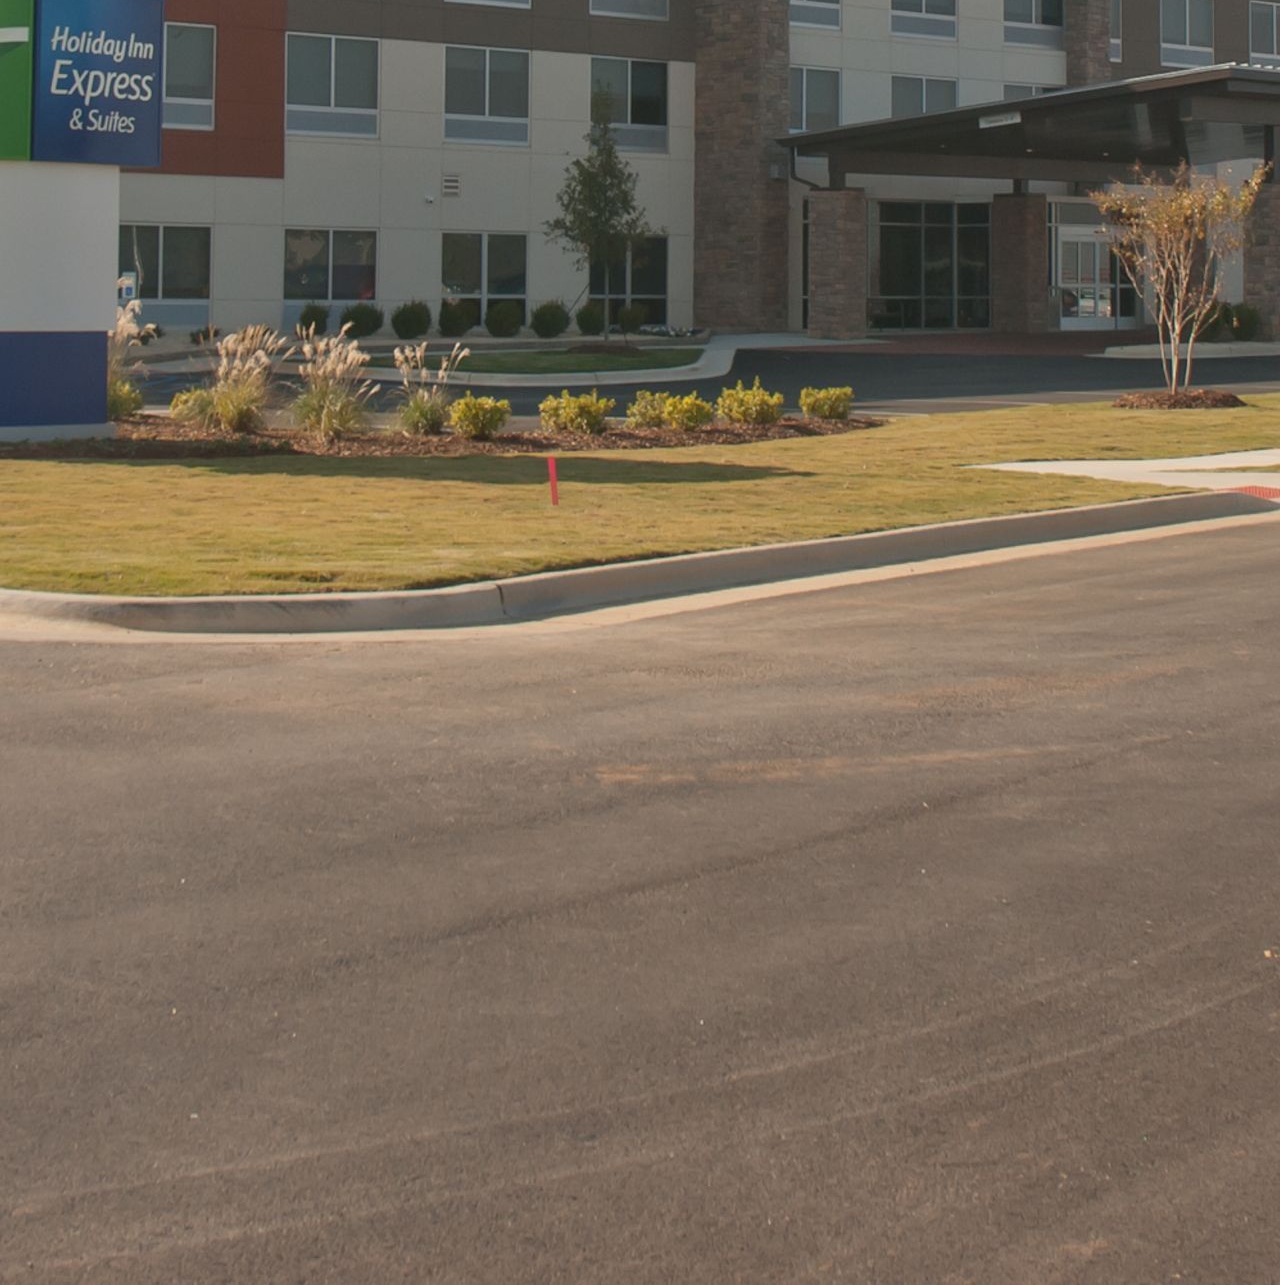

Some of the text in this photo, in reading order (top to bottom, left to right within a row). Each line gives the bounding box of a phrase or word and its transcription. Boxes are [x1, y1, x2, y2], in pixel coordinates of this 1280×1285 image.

[50, 25, 155, 63] Holiday Inn
[50, 59, 154, 107] Express
[69, 108, 136, 134] & Suites
